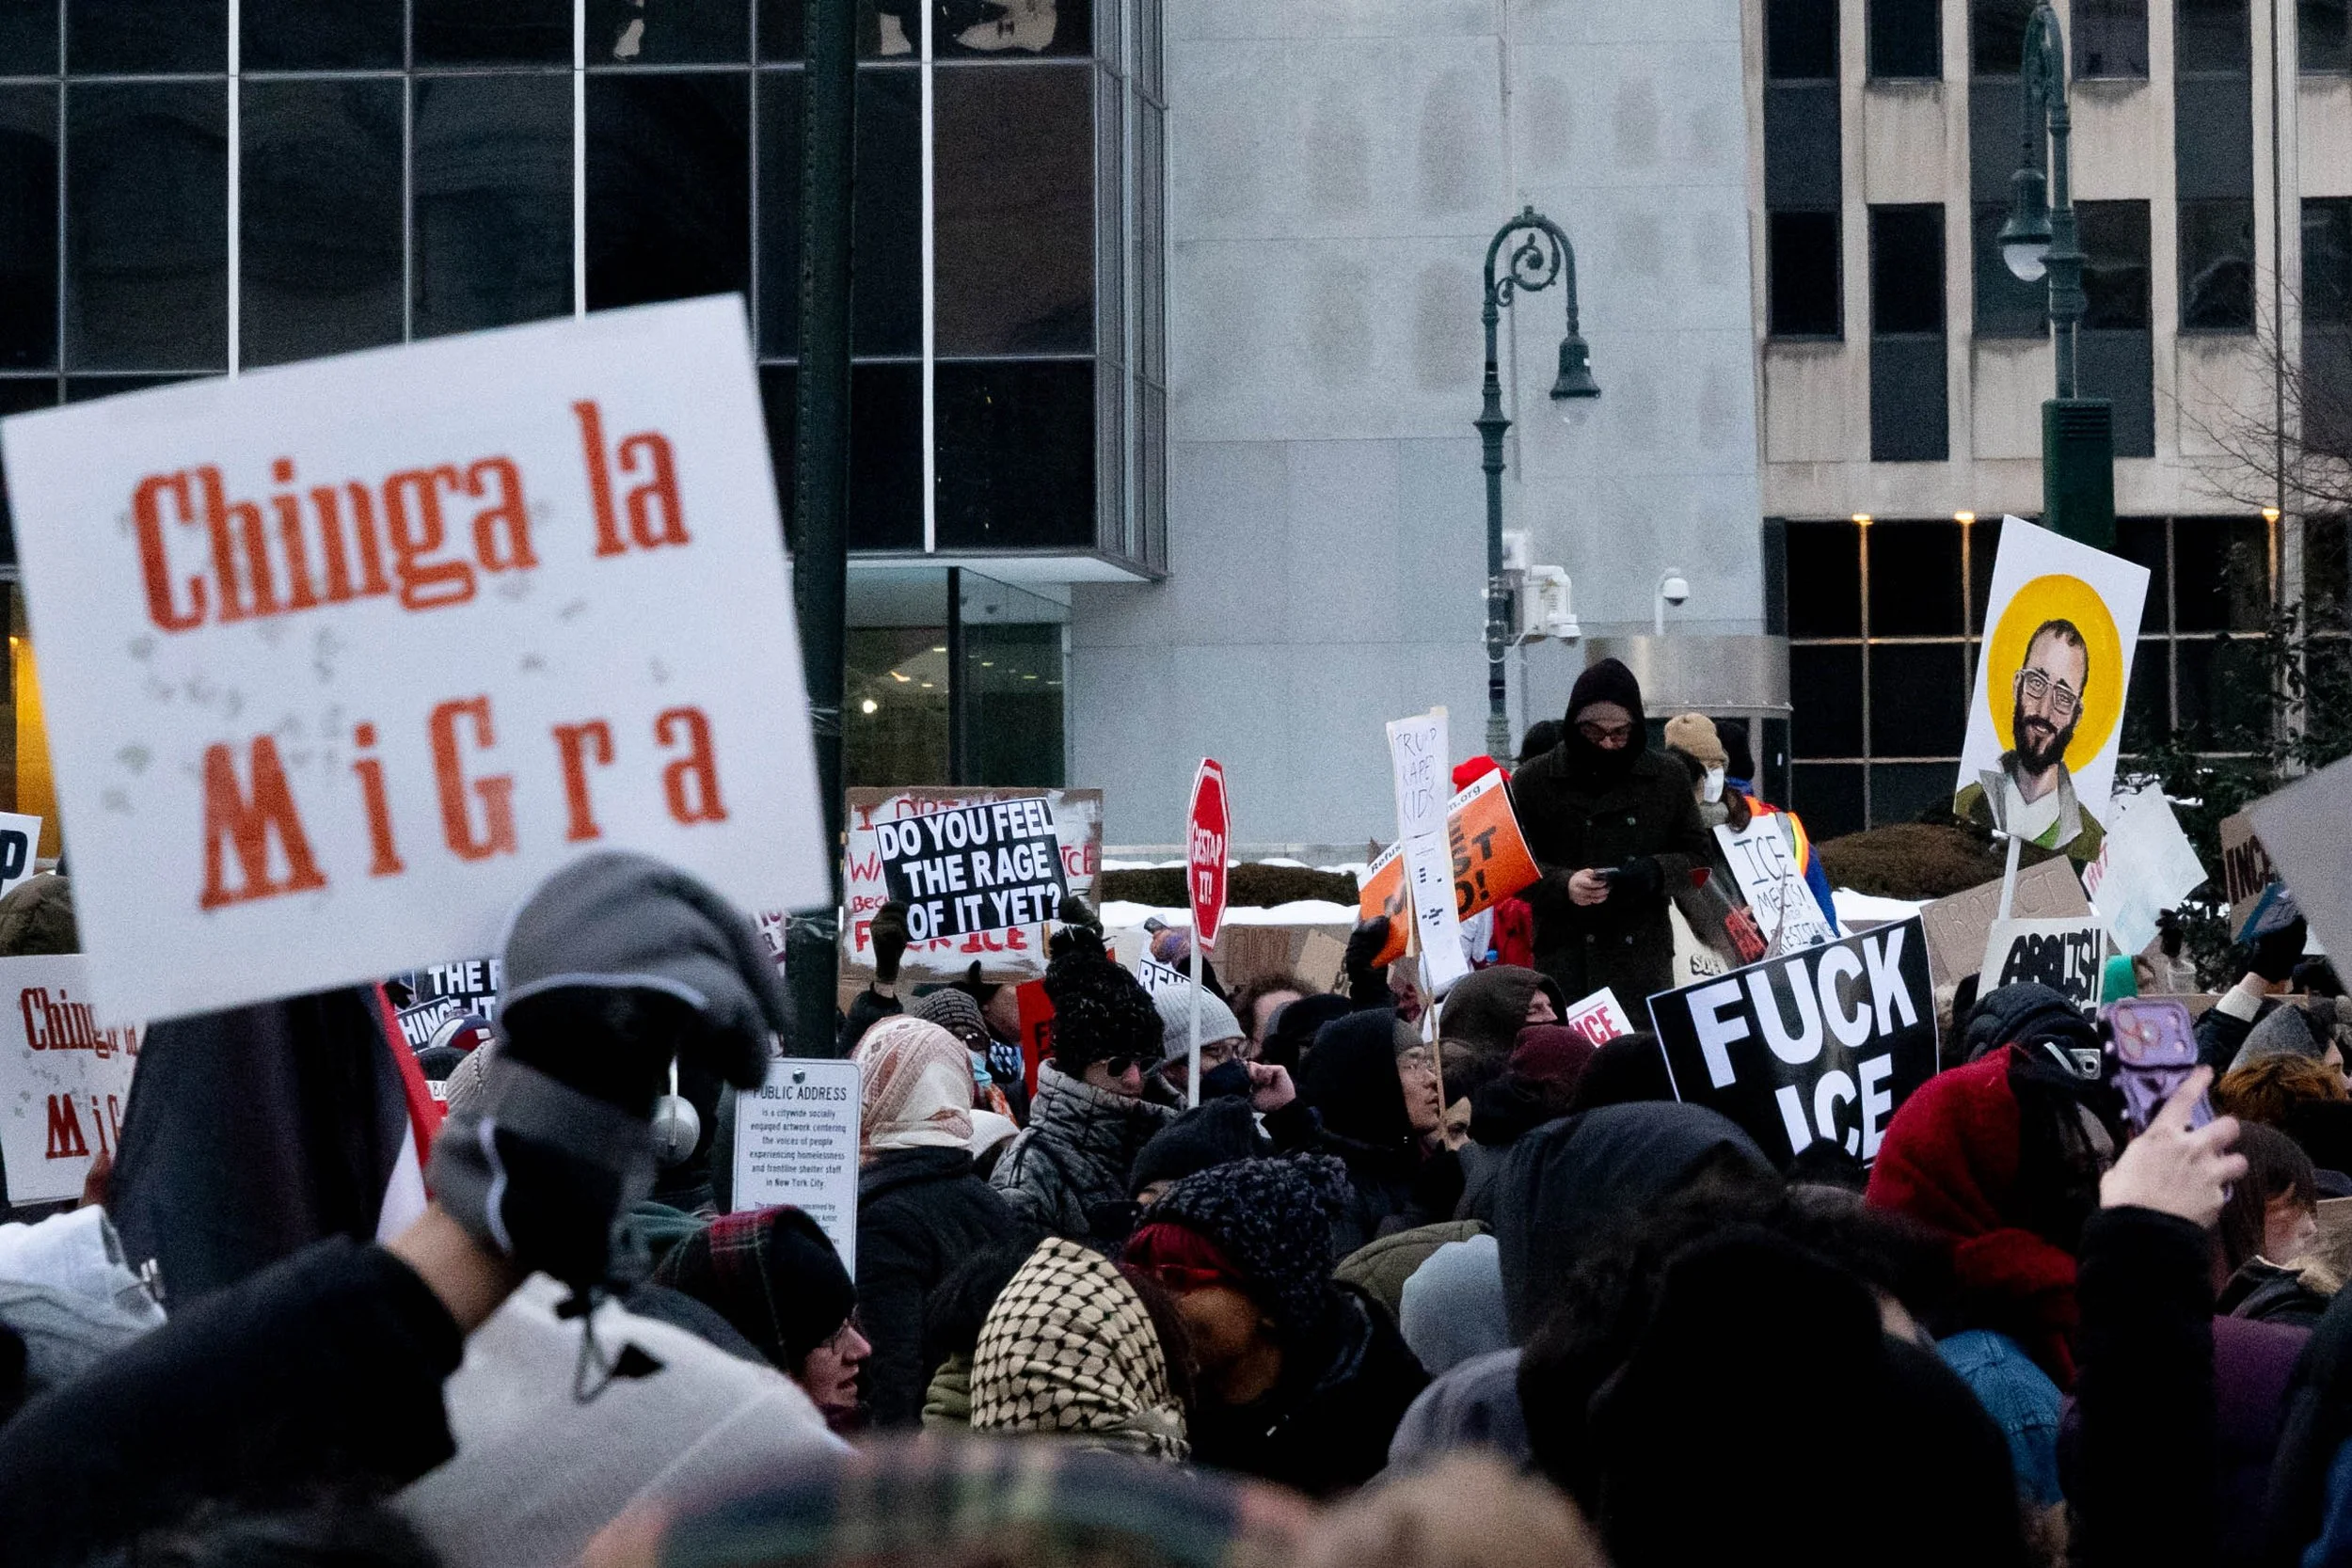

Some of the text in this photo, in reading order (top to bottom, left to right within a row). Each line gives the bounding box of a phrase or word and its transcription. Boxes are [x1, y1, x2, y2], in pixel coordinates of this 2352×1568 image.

[132, 399, 692, 634] Chinga la
[199, 695, 730, 911] MiGra
[877, 819, 922, 862] DO
[923, 807, 989, 851] YOU
[992, 800, 1057, 842] FEEL
[901, 854, 967, 897] THE
[971, 842, 1052, 888] RAGE
[1733, 835, 1794, 886] ICE
[906, 901, 945, 940] OF
[955, 895, 983, 932] IT
[989, 882, 1061, 927] YET?
[428, 960, 483, 995] THE
[1685, 927, 1919, 1090] FUCK
[776, 1109, 807, 1119] citywide
[809, 1110, 835, 1120] socially
[797, 1086, 847, 1101] ADDRESS
[1774, 1053, 1893, 1162] ICE
[751, 1122, 847, 1134] engaged artwork centering
[762, 1136, 834, 1148] the voices of people
[749, 1150, 845, 1161] experiencing homelessness
[752, 1164, 842, 1174] and frontline shelter staff
[766, 1178, 773, 1186] in
[774, 1178, 790, 1187] New
[791, 1178, 807, 1187] York
